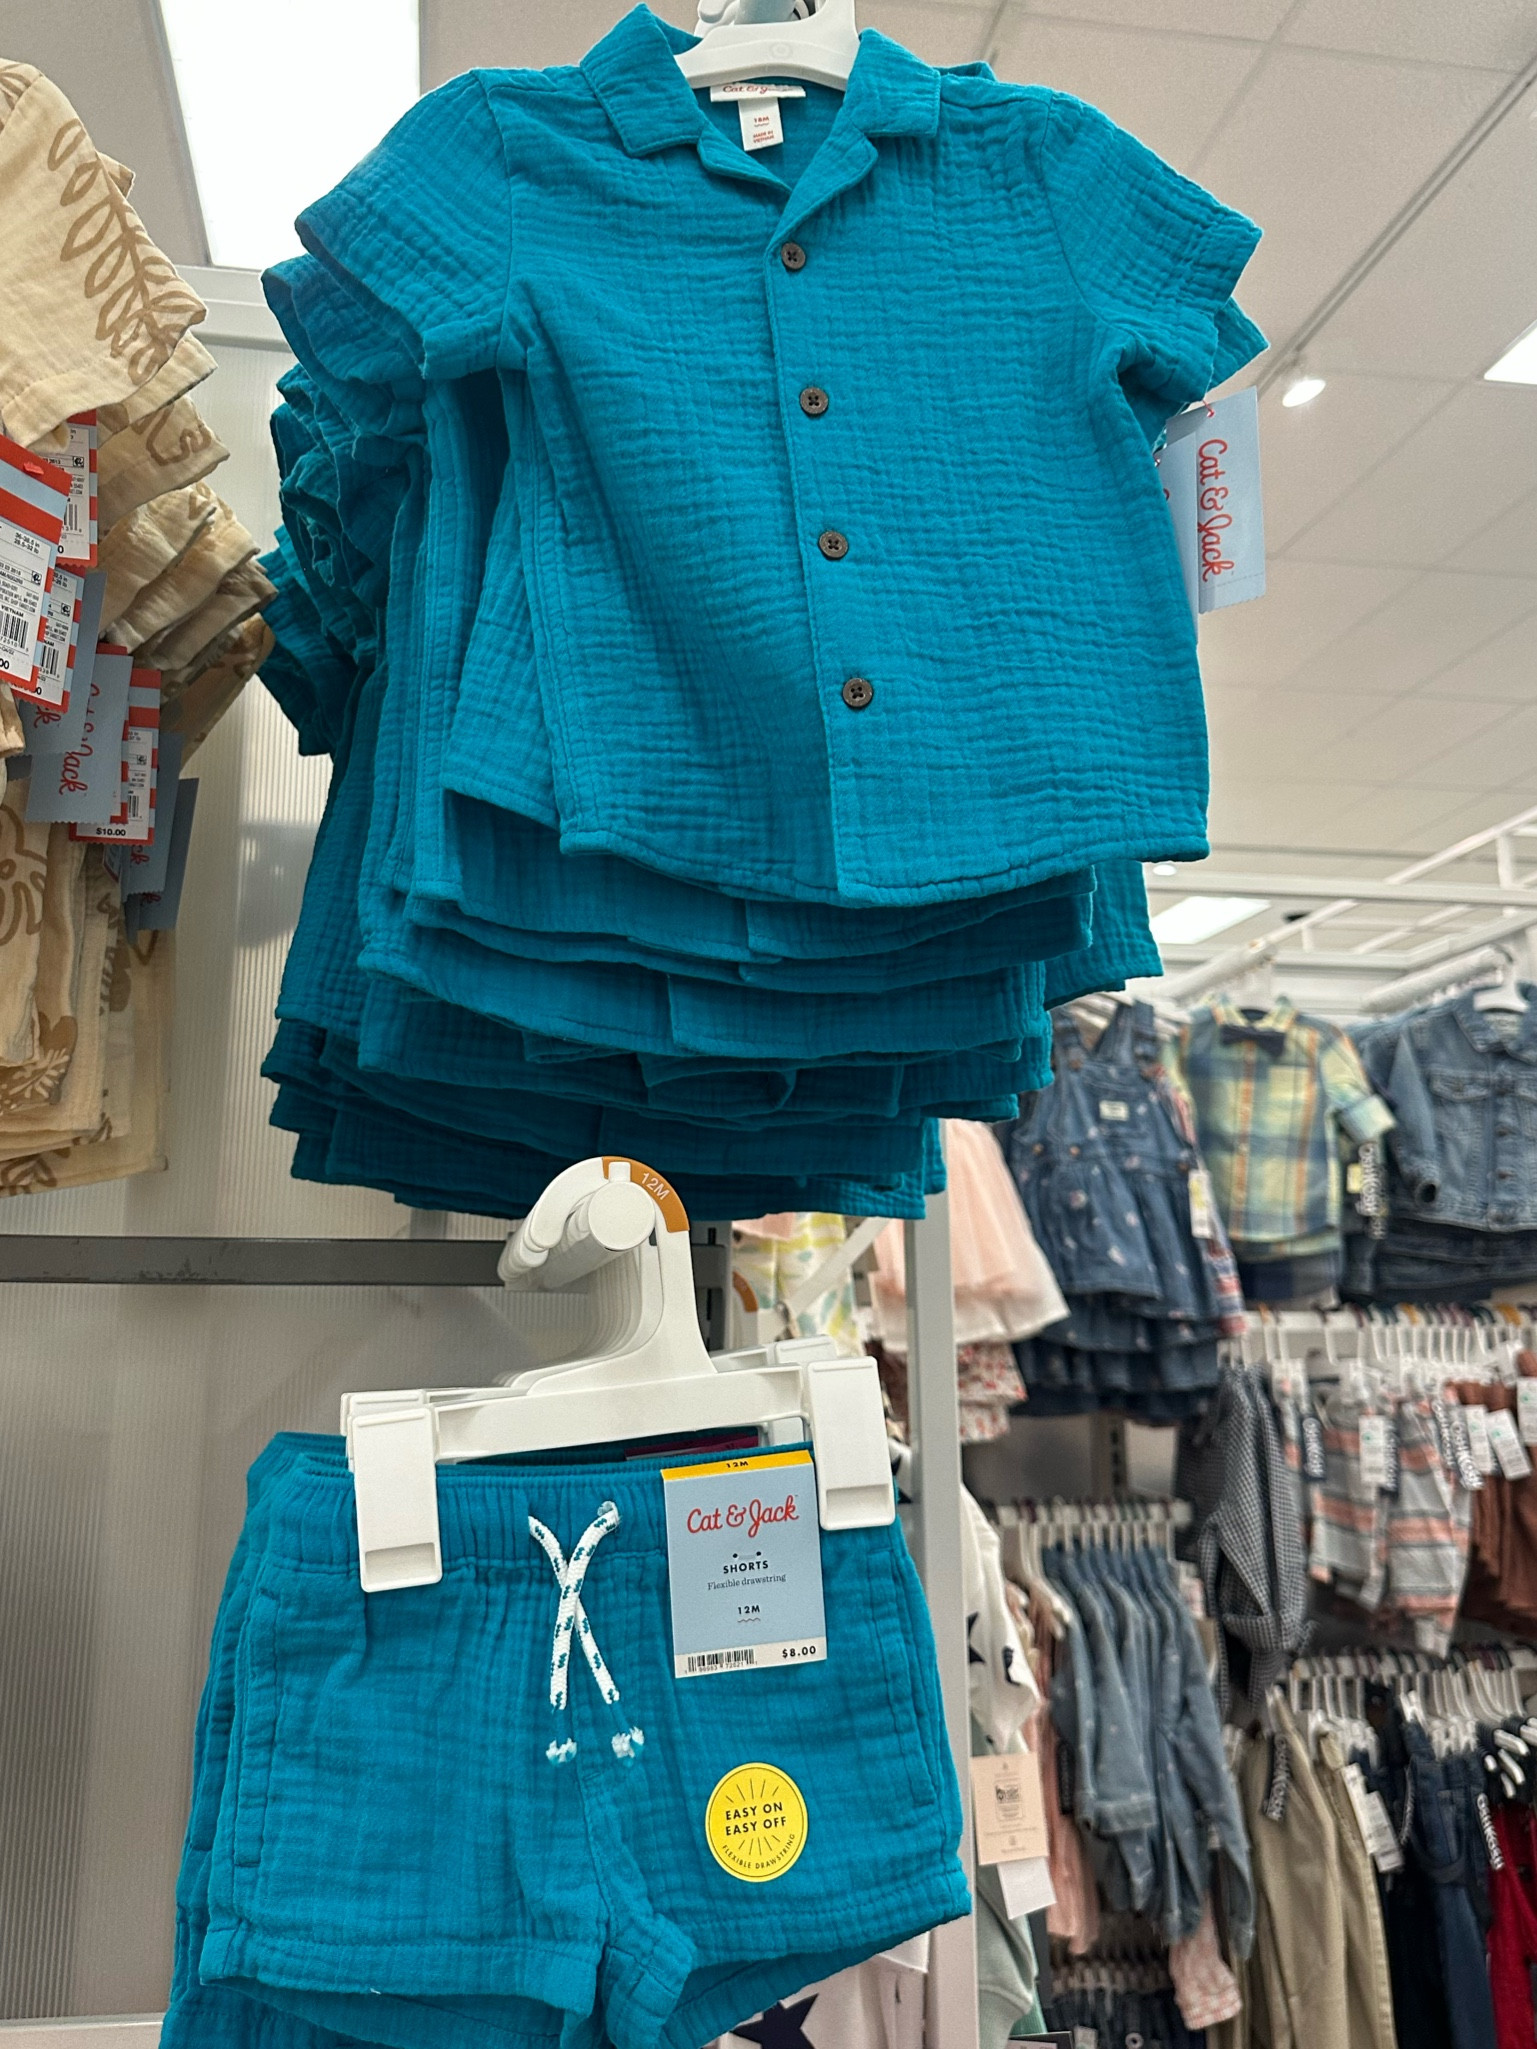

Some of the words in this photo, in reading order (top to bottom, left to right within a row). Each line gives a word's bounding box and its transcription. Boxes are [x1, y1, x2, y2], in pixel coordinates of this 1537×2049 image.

[1198, 439, 1228, 486] Cat
[1200, 486, 1229, 511] &
[1197, 513, 1234, 582] Jack
[96, 827, 126, 836] $10.00
[640, 1172, 670, 1201] 12M
[726, 1460, 749, 1468] 12M
[687, 1507, 723, 1534] Cat
[726, 1504, 747, 1528] &
[748, 1494, 800, 1538] Jack
[723, 1560, 769, 1574] SHORTS
[707, 1577, 741, 1591] Flexible
[741, 1573, 787, 1587] drawstring
[737, 1604, 761, 1615] 12M
[782, 1645, 817, 1659] $8.00
[725, 1805, 757, 1821] EASY
[763, 1801, 783, 1814] ON
[725, 1821, 757, 1836] EASY
[763, 1816, 787, 1829] OFF
[722, 1844, 752, 1869] FLEXIBLE
[755, 1833, 795, 1869] DRAWSTRING
